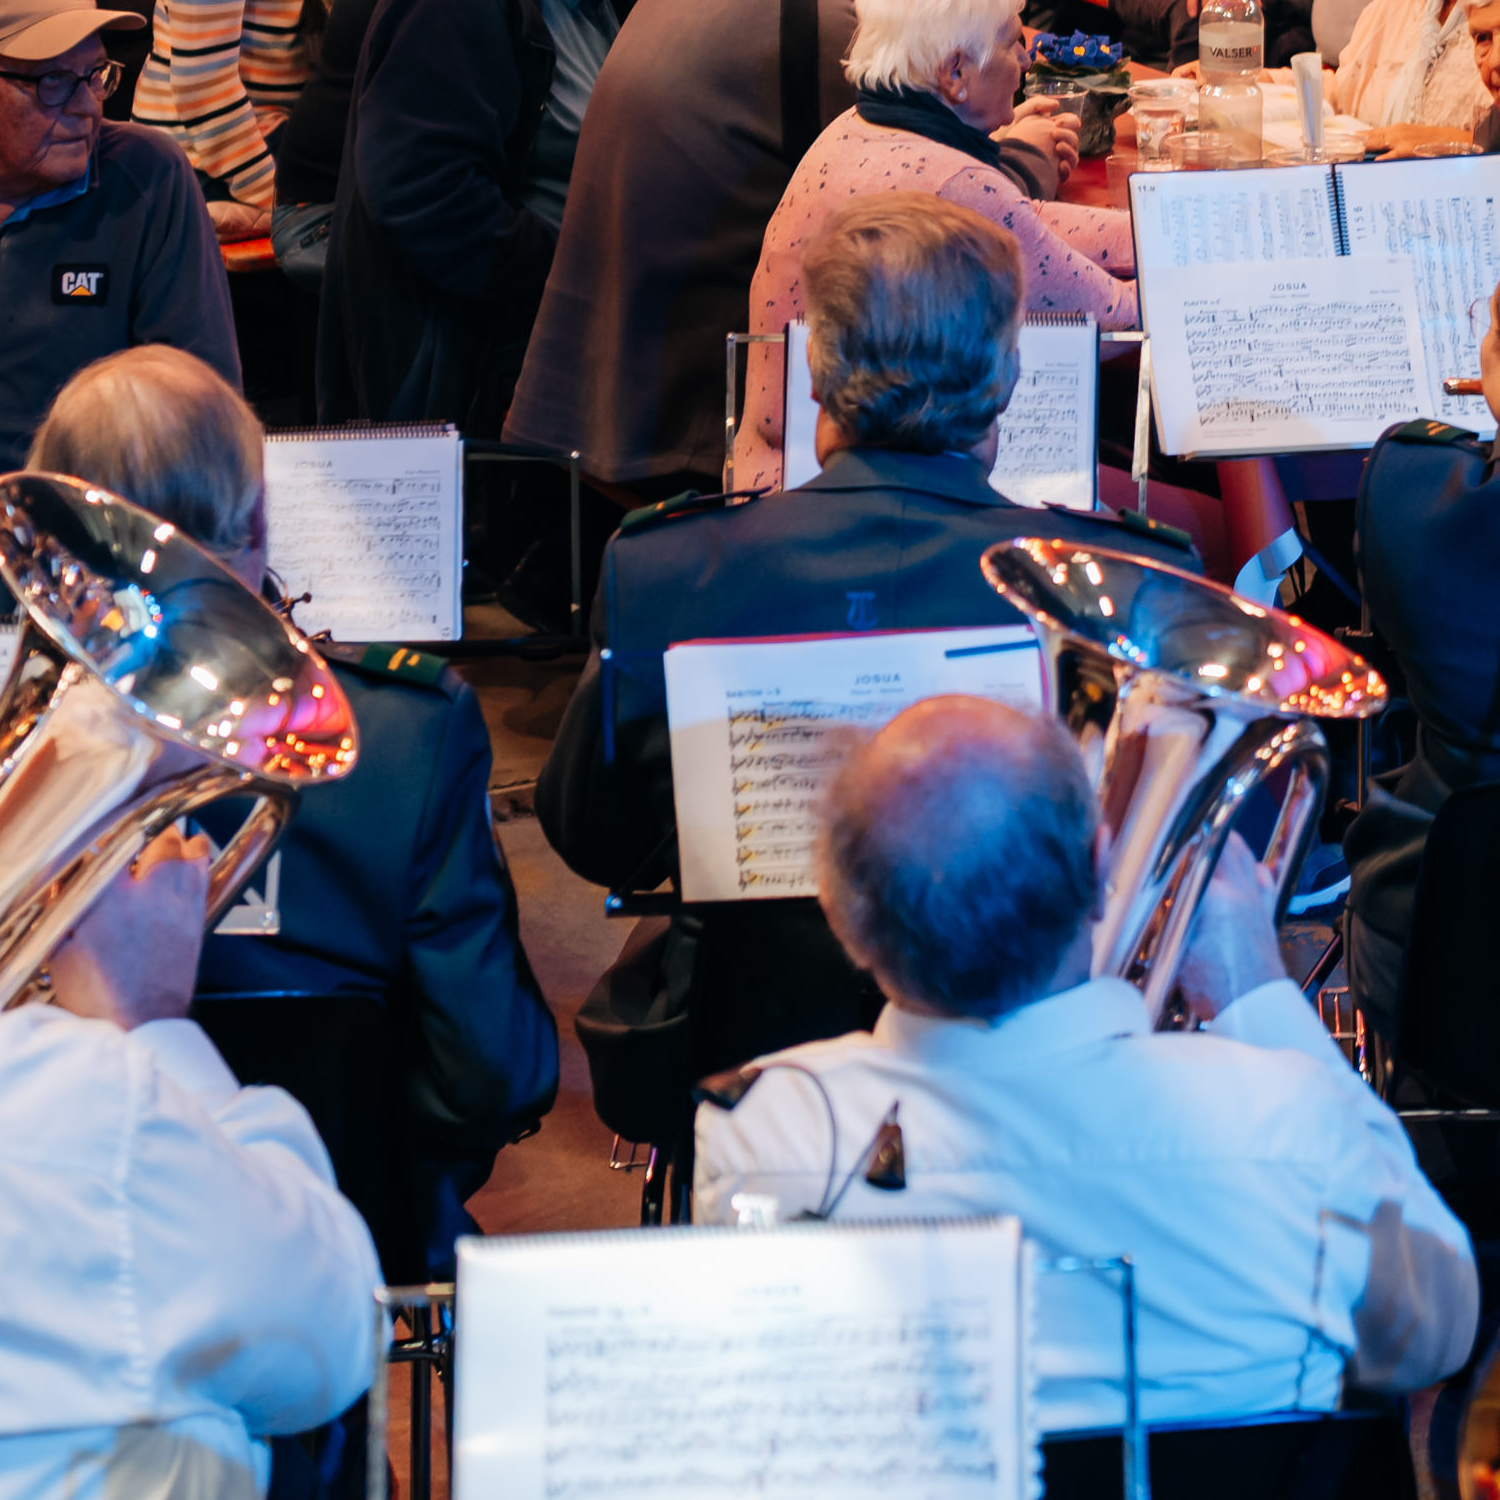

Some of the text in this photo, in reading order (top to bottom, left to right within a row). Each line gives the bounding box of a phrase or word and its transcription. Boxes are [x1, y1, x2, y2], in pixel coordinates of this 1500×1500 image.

[1211, 47, 1252, 59] VALSER
[62, 272, 101, 296] CAT
[1272, 282, 1308, 292] JOSUA
[294, 461, 333, 469] JOSUA
[855, 673, 900, 684] JOSUA
